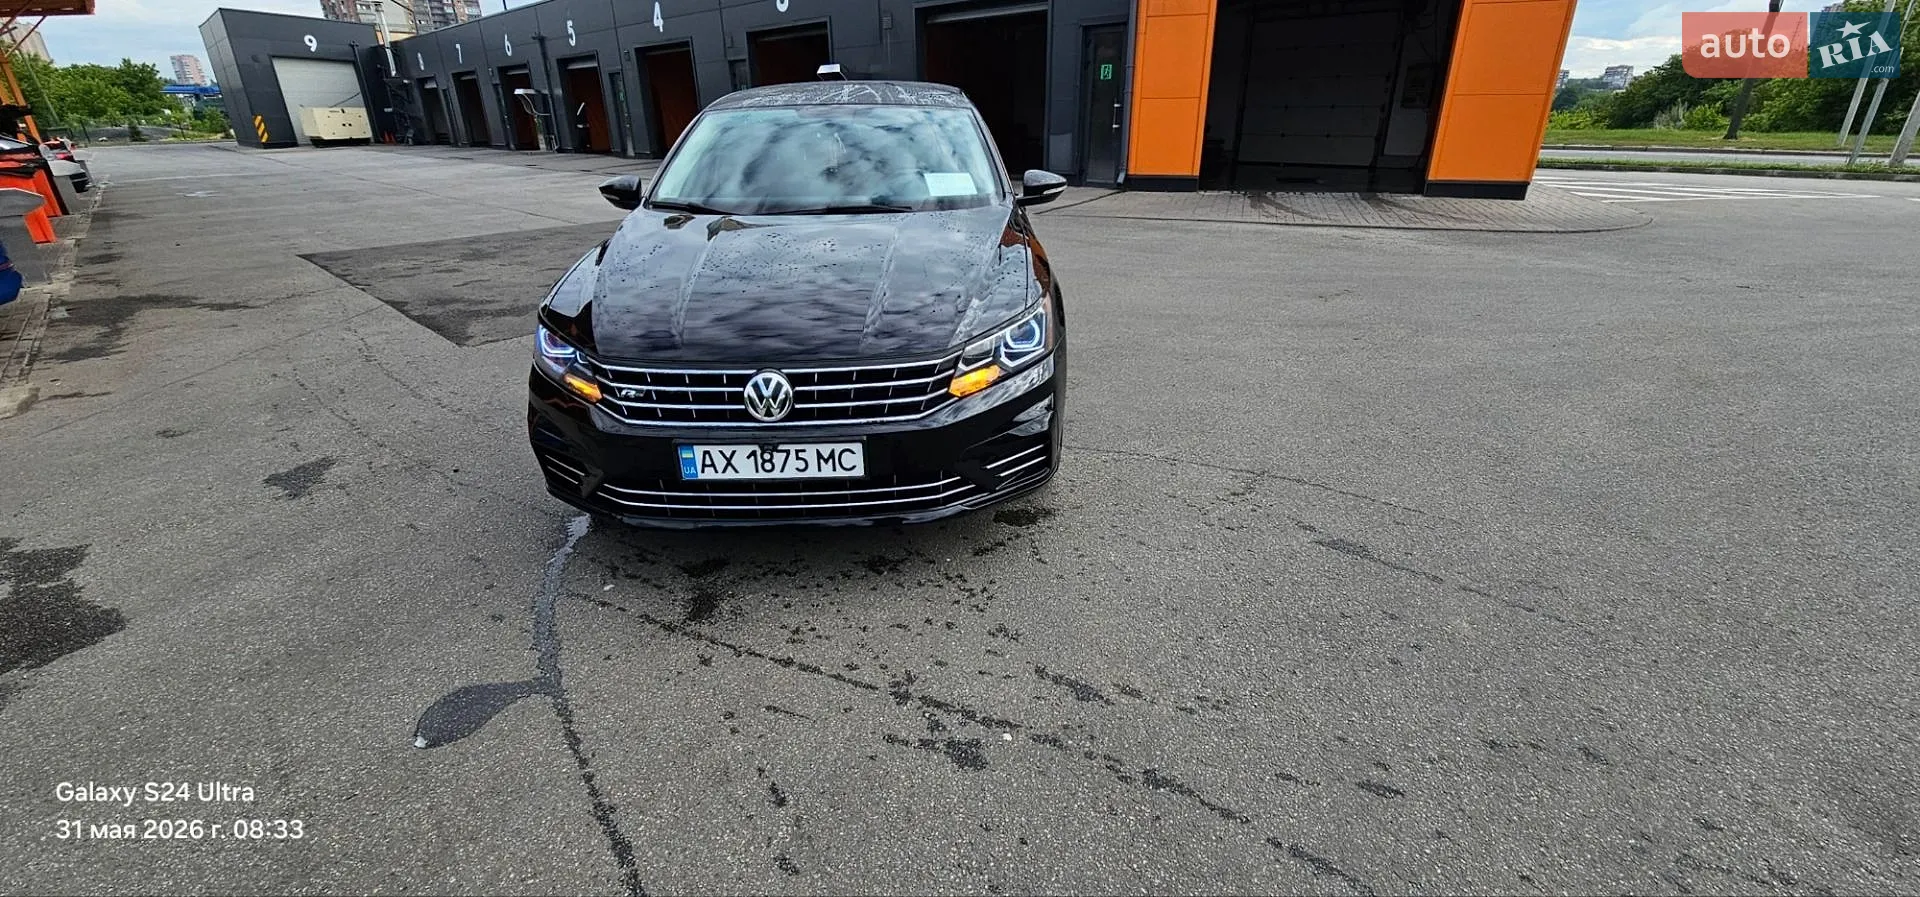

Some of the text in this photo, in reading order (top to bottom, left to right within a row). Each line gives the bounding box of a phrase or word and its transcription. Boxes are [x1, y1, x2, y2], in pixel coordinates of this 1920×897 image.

[653, 1, 664, 32] 4
[303, 34, 318, 53] 9
[504, 33, 513, 57] 6
[566, 19, 577, 47] 5
[455, 43, 464, 65] 7
[683, 466, 697, 475] UA
[701, 448, 857, 474] AX 1875 MC
